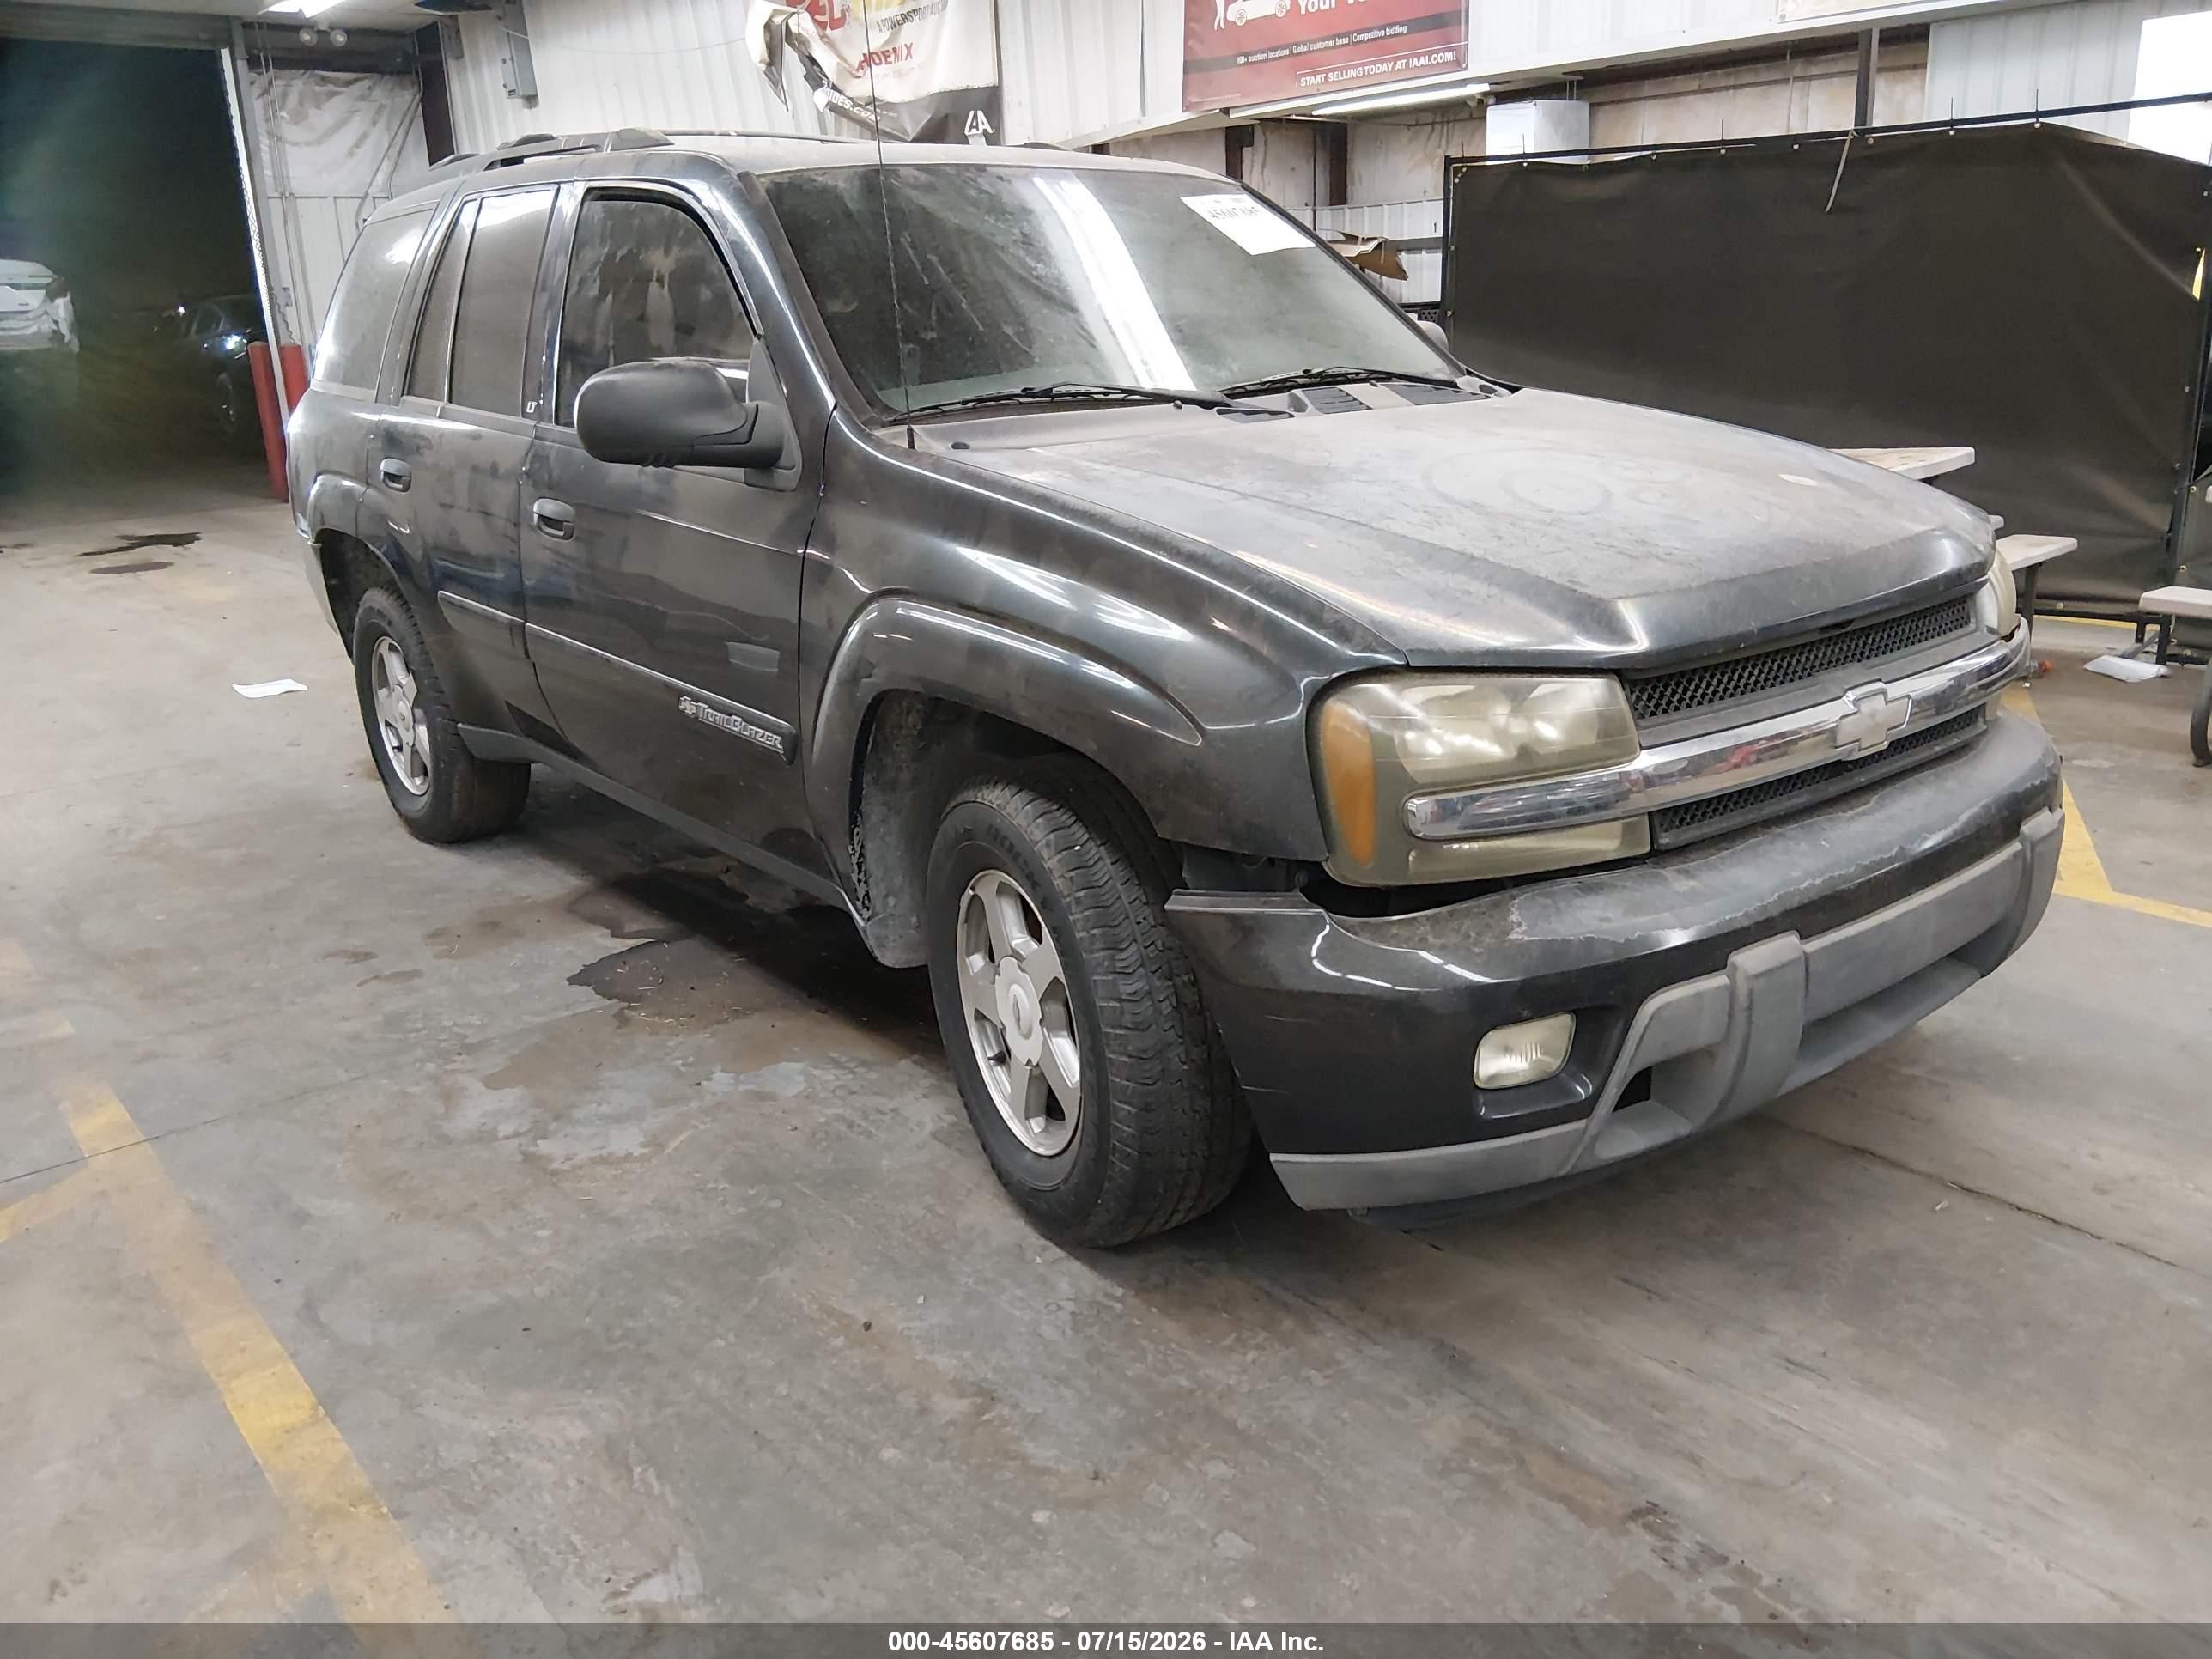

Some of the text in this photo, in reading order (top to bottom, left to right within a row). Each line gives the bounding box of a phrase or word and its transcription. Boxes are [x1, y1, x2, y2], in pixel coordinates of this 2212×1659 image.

[883, 4, 930, 33] POWERSPORT
[1248, 52, 1267, 63] auction
[1267, 47, 1290, 59] locations
[1292, 41, 1310, 54] Global
[1310, 39, 1335, 51] customer
[1335, 37, 1350, 46] base
[1352, 28, 1385, 42] Competitive
[1385, 24, 1407, 36] bidding
[1299, 50, 1457, 87] START SELLING TODAY AT IAAI.COM!
